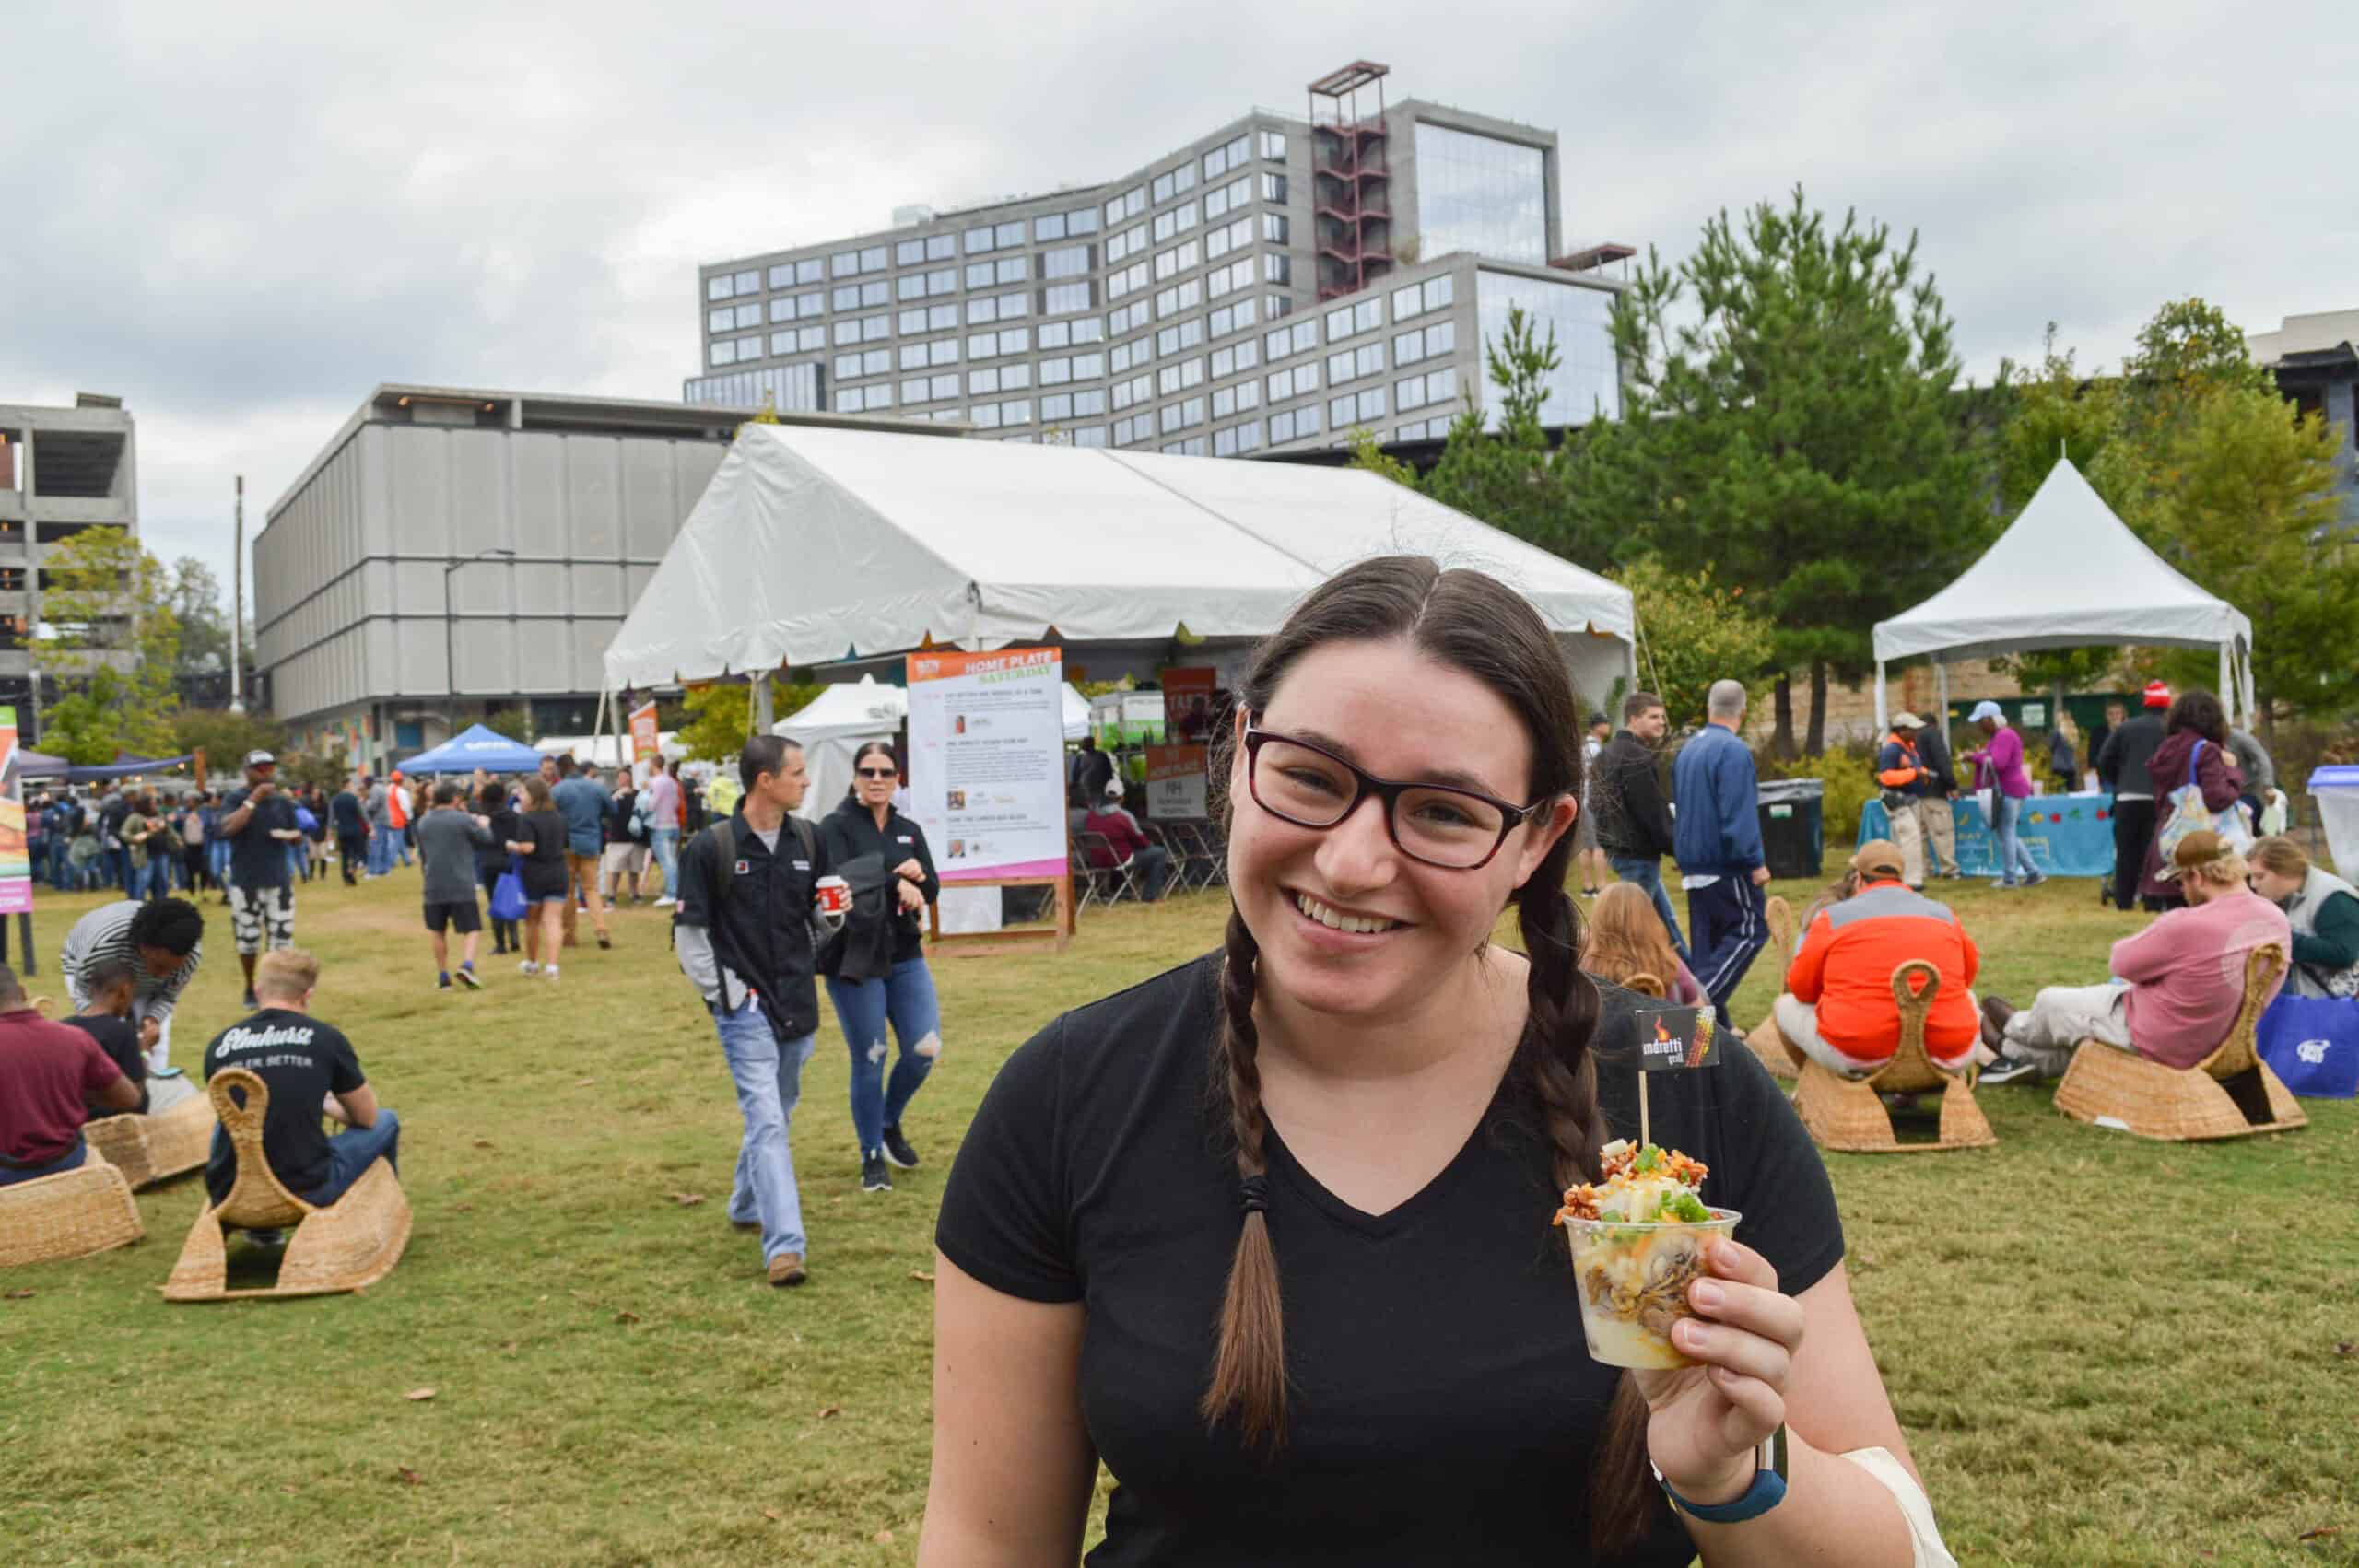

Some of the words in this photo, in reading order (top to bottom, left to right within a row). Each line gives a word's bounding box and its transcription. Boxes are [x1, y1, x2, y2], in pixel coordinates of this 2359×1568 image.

[965, 659, 1003, 675] HOME
[1010, 650, 1052, 667] PLATE
[980, 664, 1051, 685] SATURDAY
[215, 1024, 314, 1059] Elmhurst
